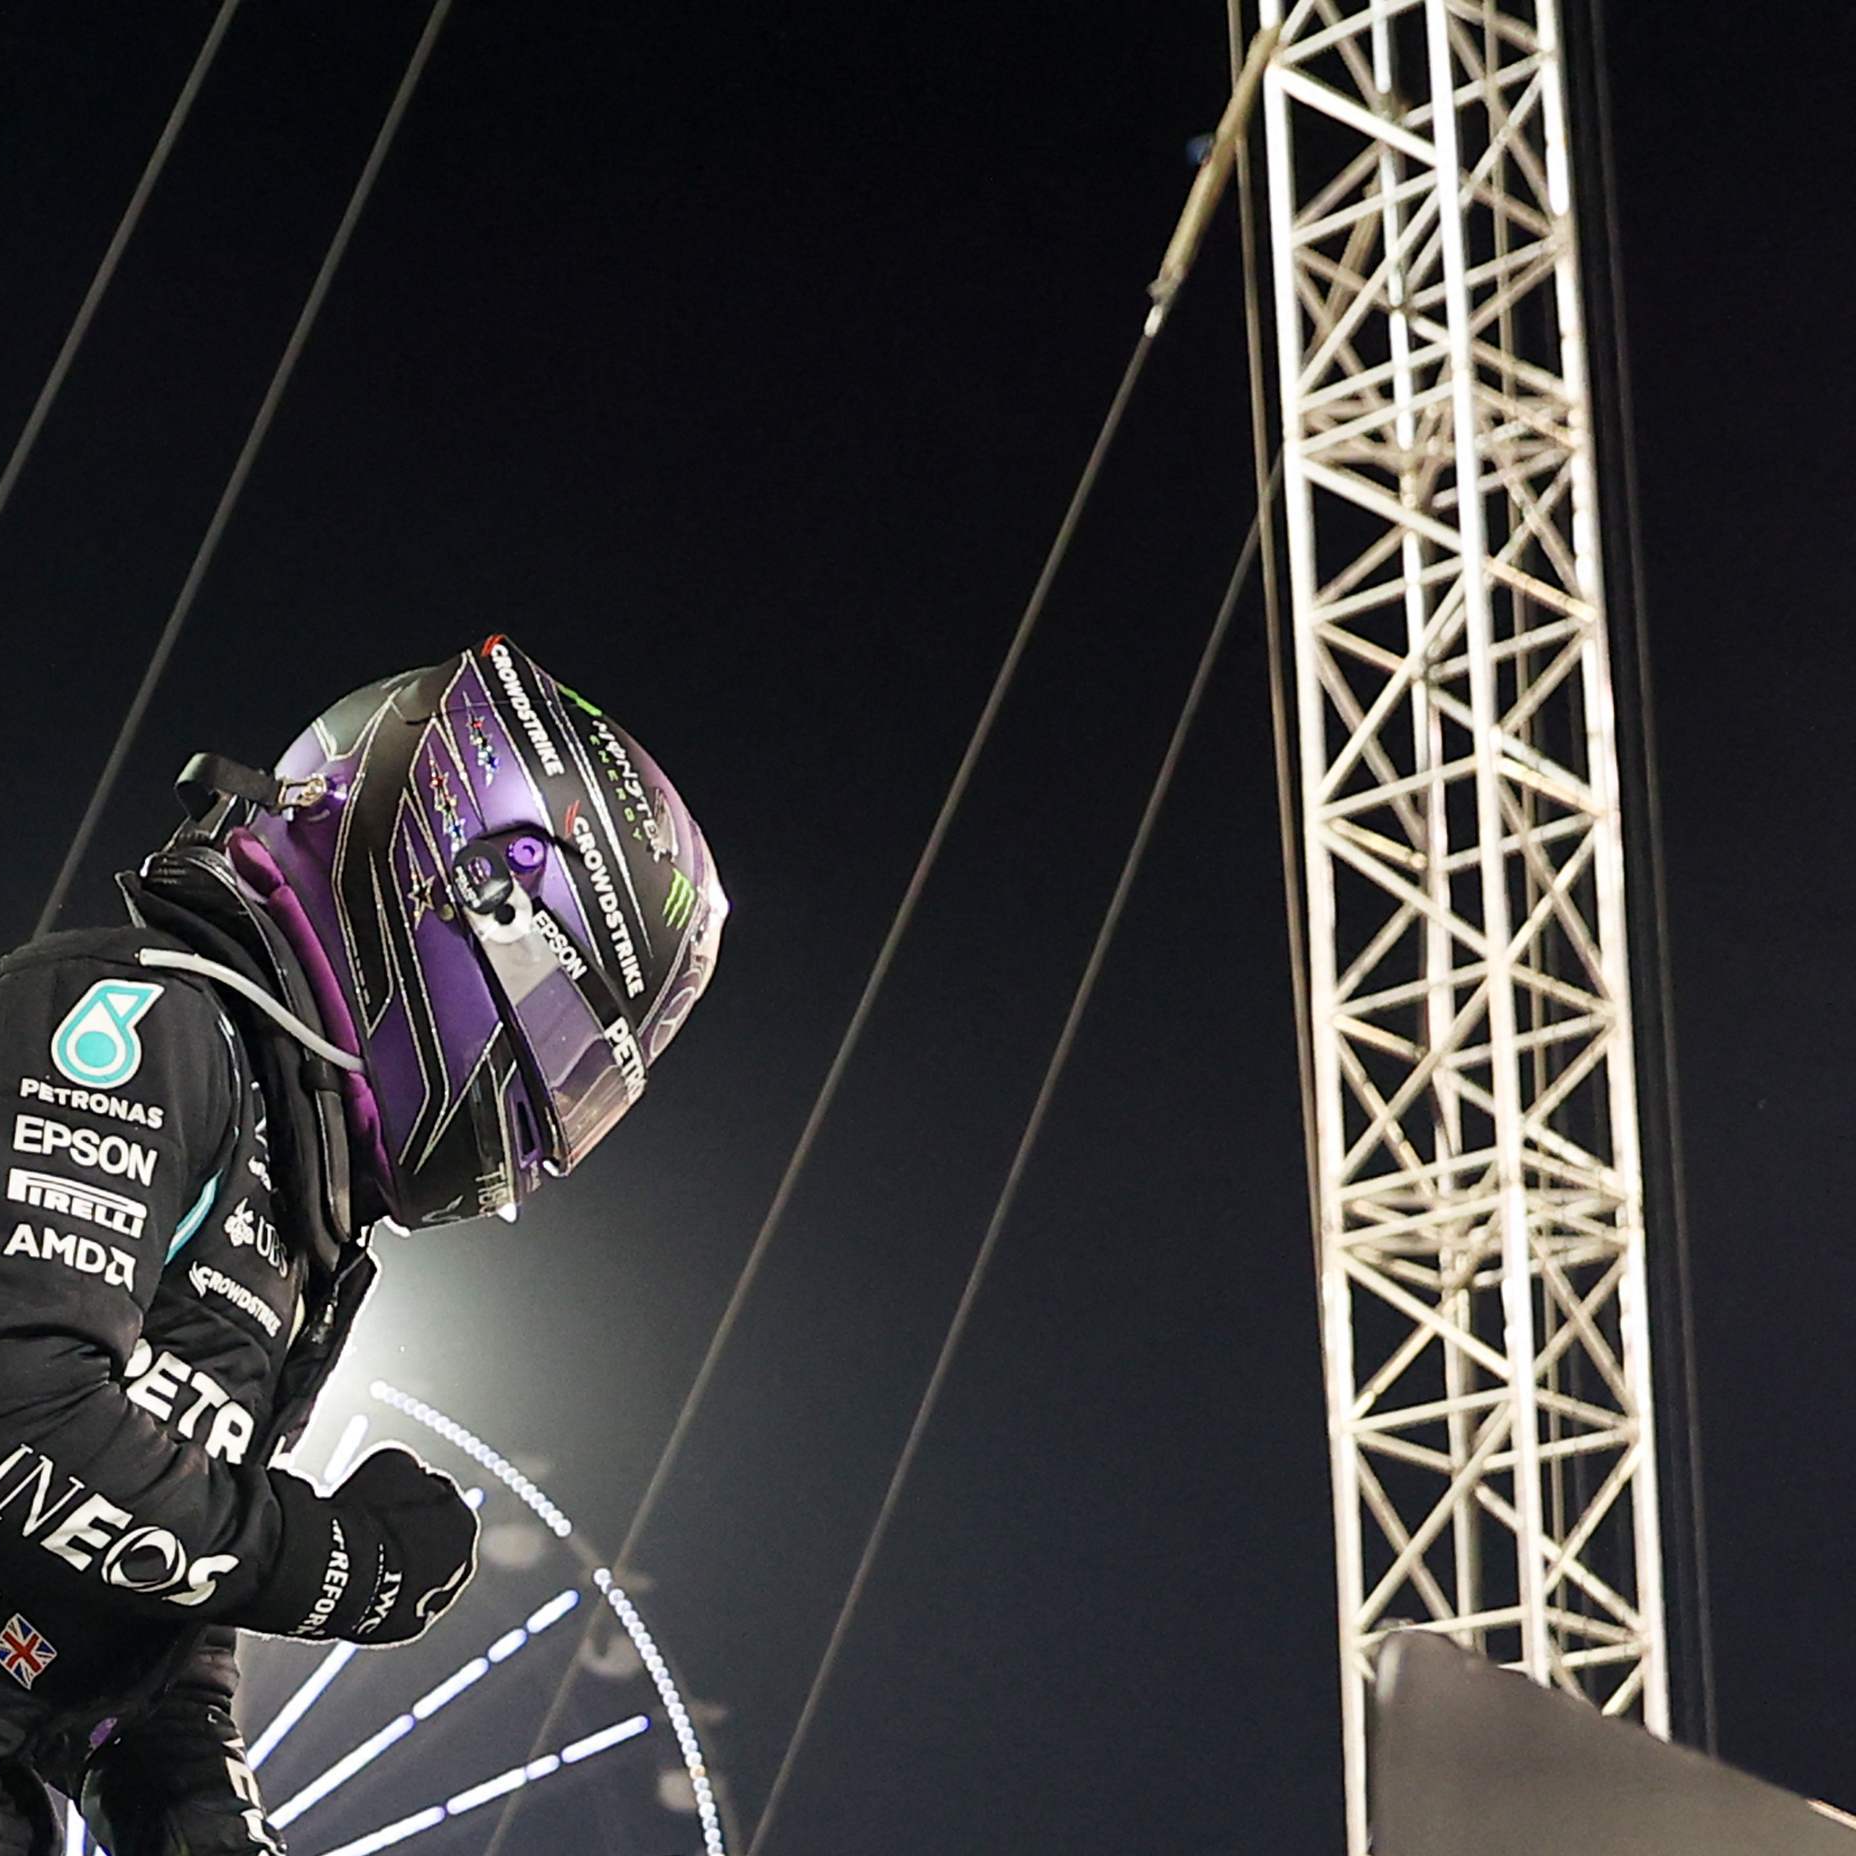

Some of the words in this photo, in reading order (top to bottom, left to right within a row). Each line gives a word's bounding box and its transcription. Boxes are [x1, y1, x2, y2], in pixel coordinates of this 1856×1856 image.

[490, 643, 565, 777] CROWDSTRIKE
[573, 816, 645, 998] CROWDSTRIKE
[532, 909, 588, 981] EPSON
[20, 1078, 164, 1130] PETRONAS
[13, 1114, 158, 1187] EPSON
[7, 1167, 147, 1239] PIRELLI
[256, 1215, 289, 1279] UBS
[190, 1262, 282, 1338] CROWDSTRIKE
